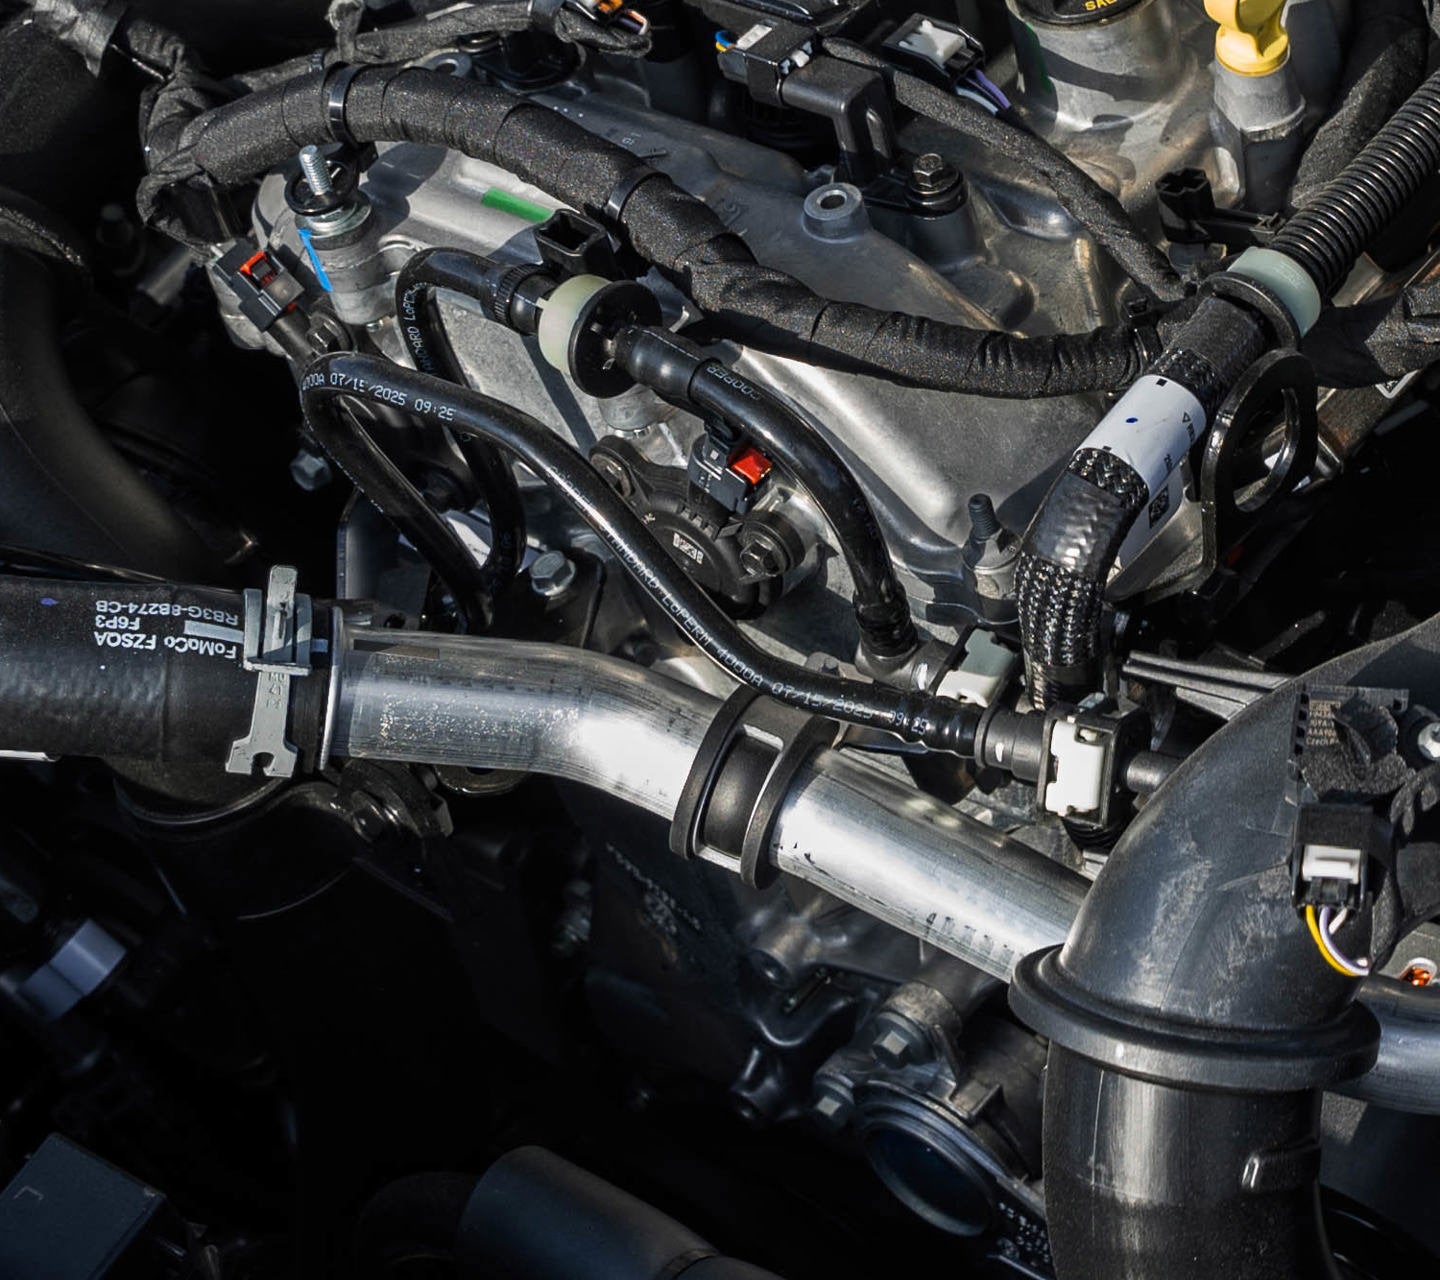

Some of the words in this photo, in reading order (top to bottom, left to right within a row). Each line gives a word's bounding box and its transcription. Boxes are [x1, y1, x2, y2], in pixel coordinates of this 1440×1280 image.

[413, 397, 456, 422] 09:25
[94, 614, 140, 630] F6P3
[95, 598, 238, 625] RB3G-8B274-CB
[163, 634, 237, 658] FoMoCo
